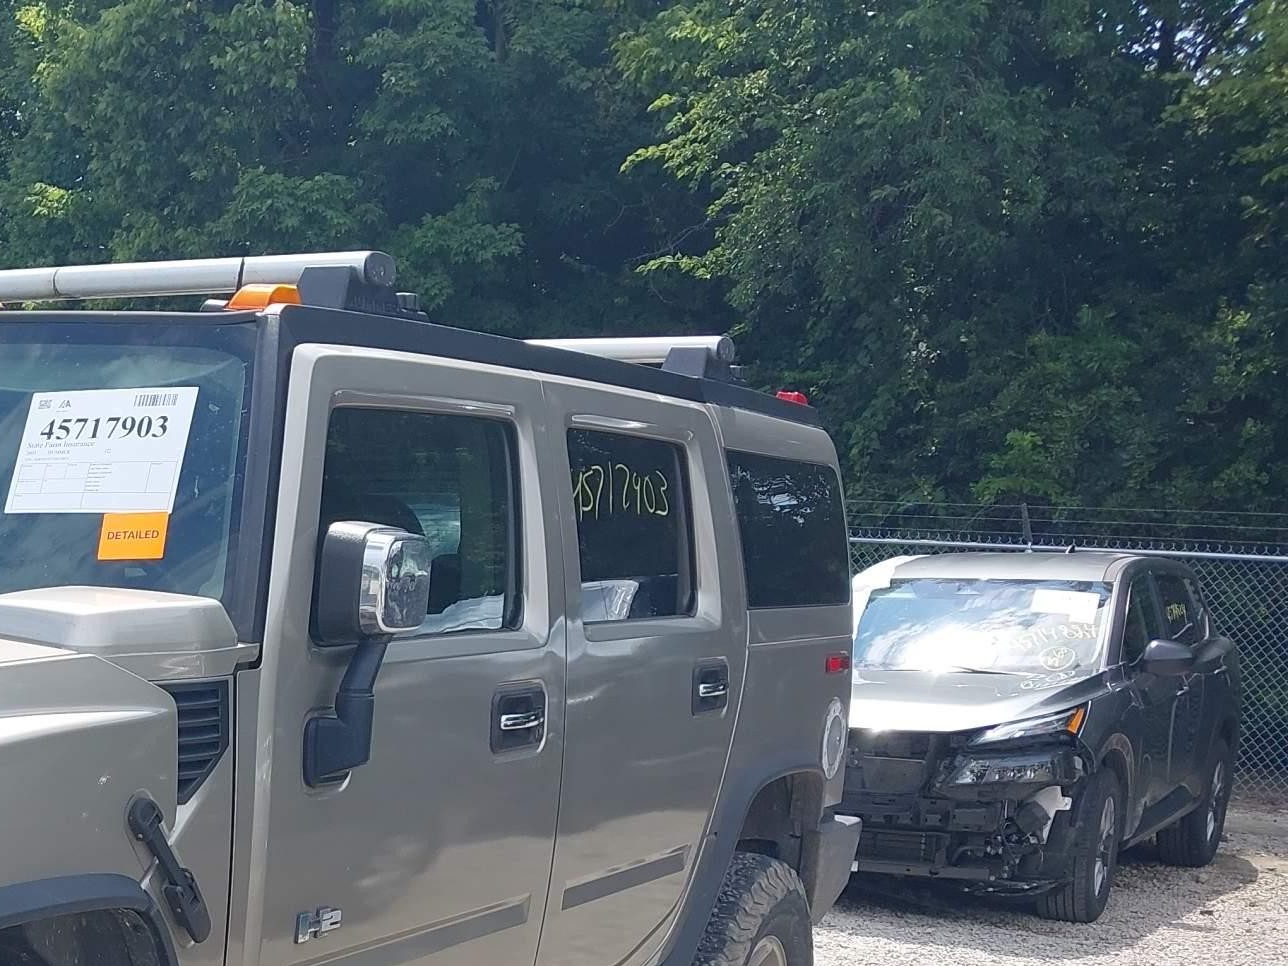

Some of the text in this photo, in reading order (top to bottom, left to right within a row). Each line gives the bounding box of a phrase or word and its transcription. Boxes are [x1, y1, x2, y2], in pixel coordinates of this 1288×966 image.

[39, 415, 169, 441] 45717903
[107, 529, 160, 541] DETAILED
[295, 906, 343, 944] H2
